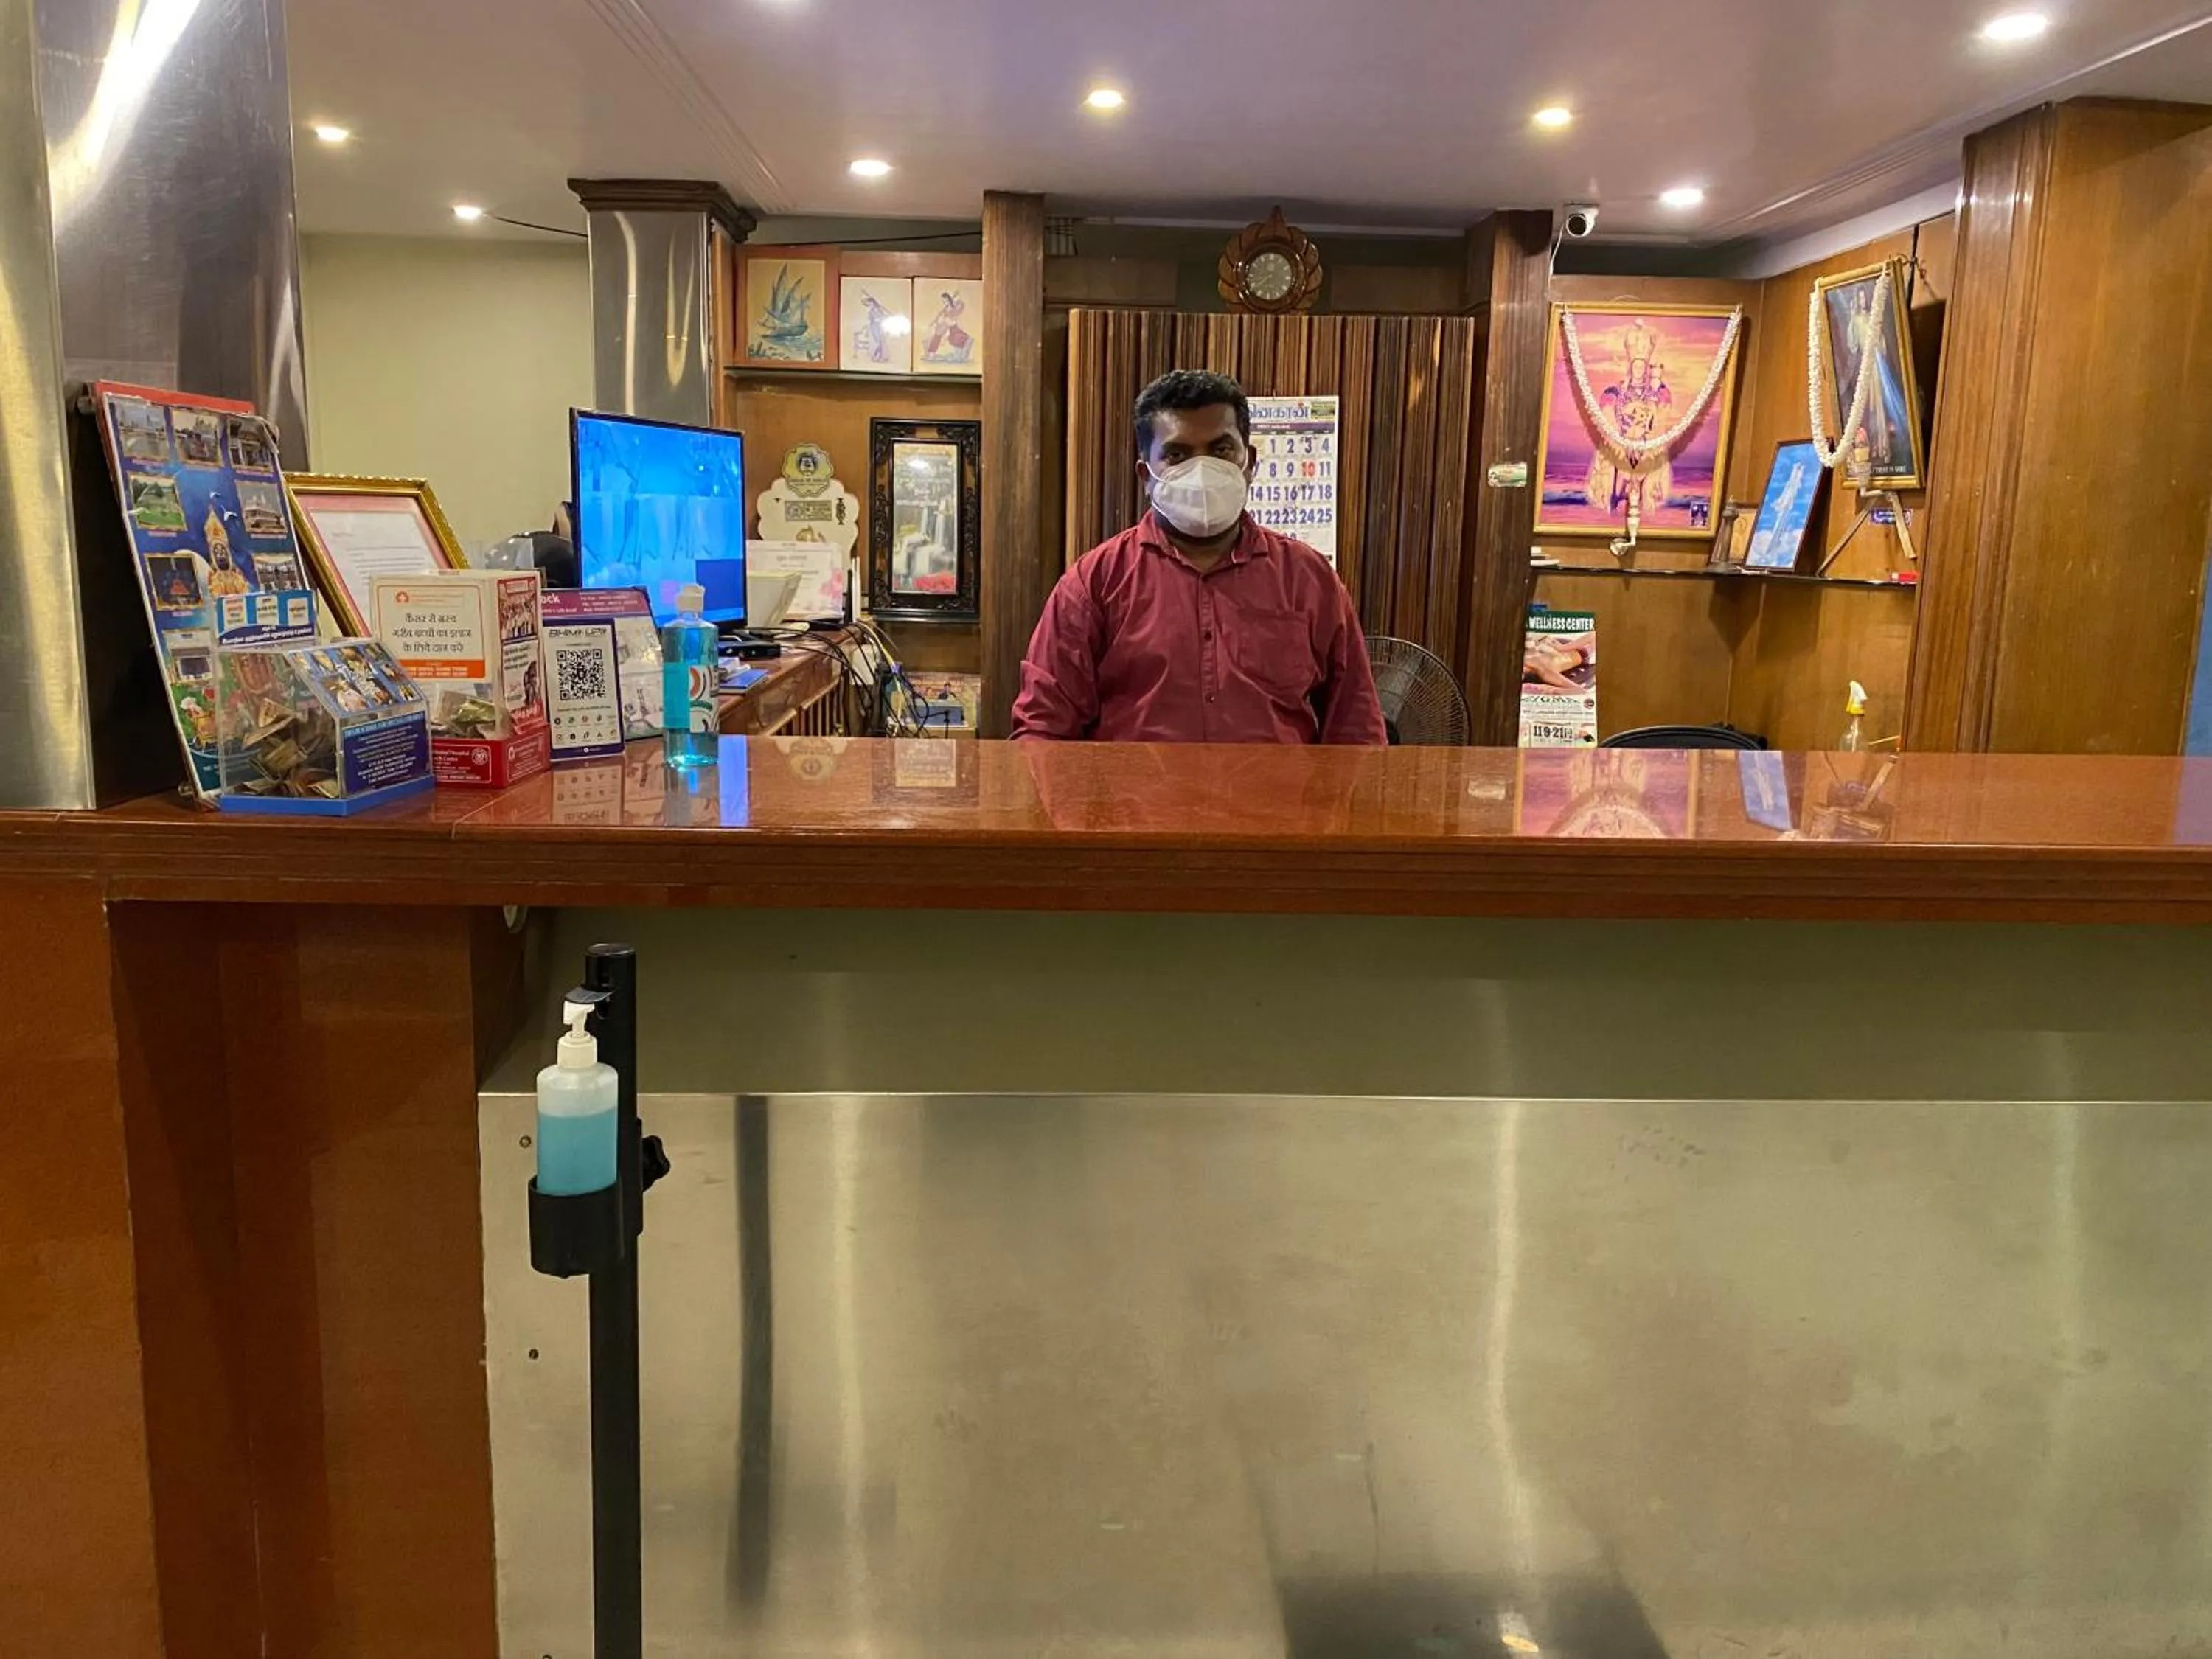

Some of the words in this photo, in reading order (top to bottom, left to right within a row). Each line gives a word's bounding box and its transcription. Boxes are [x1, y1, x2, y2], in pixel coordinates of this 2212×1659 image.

[1270, 438, 1276, 453] 1
[1287, 438, 1294, 453] 2
[1304, 437, 1312, 453] 3
[1321, 437, 1329, 453] 4
[1269, 462, 1276, 477] 8
[1287, 462, 1294, 476] 9
[1301, 462, 1315, 476] 10
[1320, 462, 1331, 476] 11
[1250, 487, 1263, 500] 14
[1267, 486, 1281, 500] 15
[1284, 486, 1298, 500] 16
[1301, 484, 1315, 500] 17
[1318, 484, 1332, 499] 18
[1265, 510, 1280, 524] 22
[1282, 508, 1297, 524] 23
[1299, 509, 1315, 524] 24
[1317, 508, 1332, 523] 25
[542, 593, 560, 604] ock
[1529, 616, 1565, 630] WELLNESS
[1566, 618, 1595, 630] CENTER
